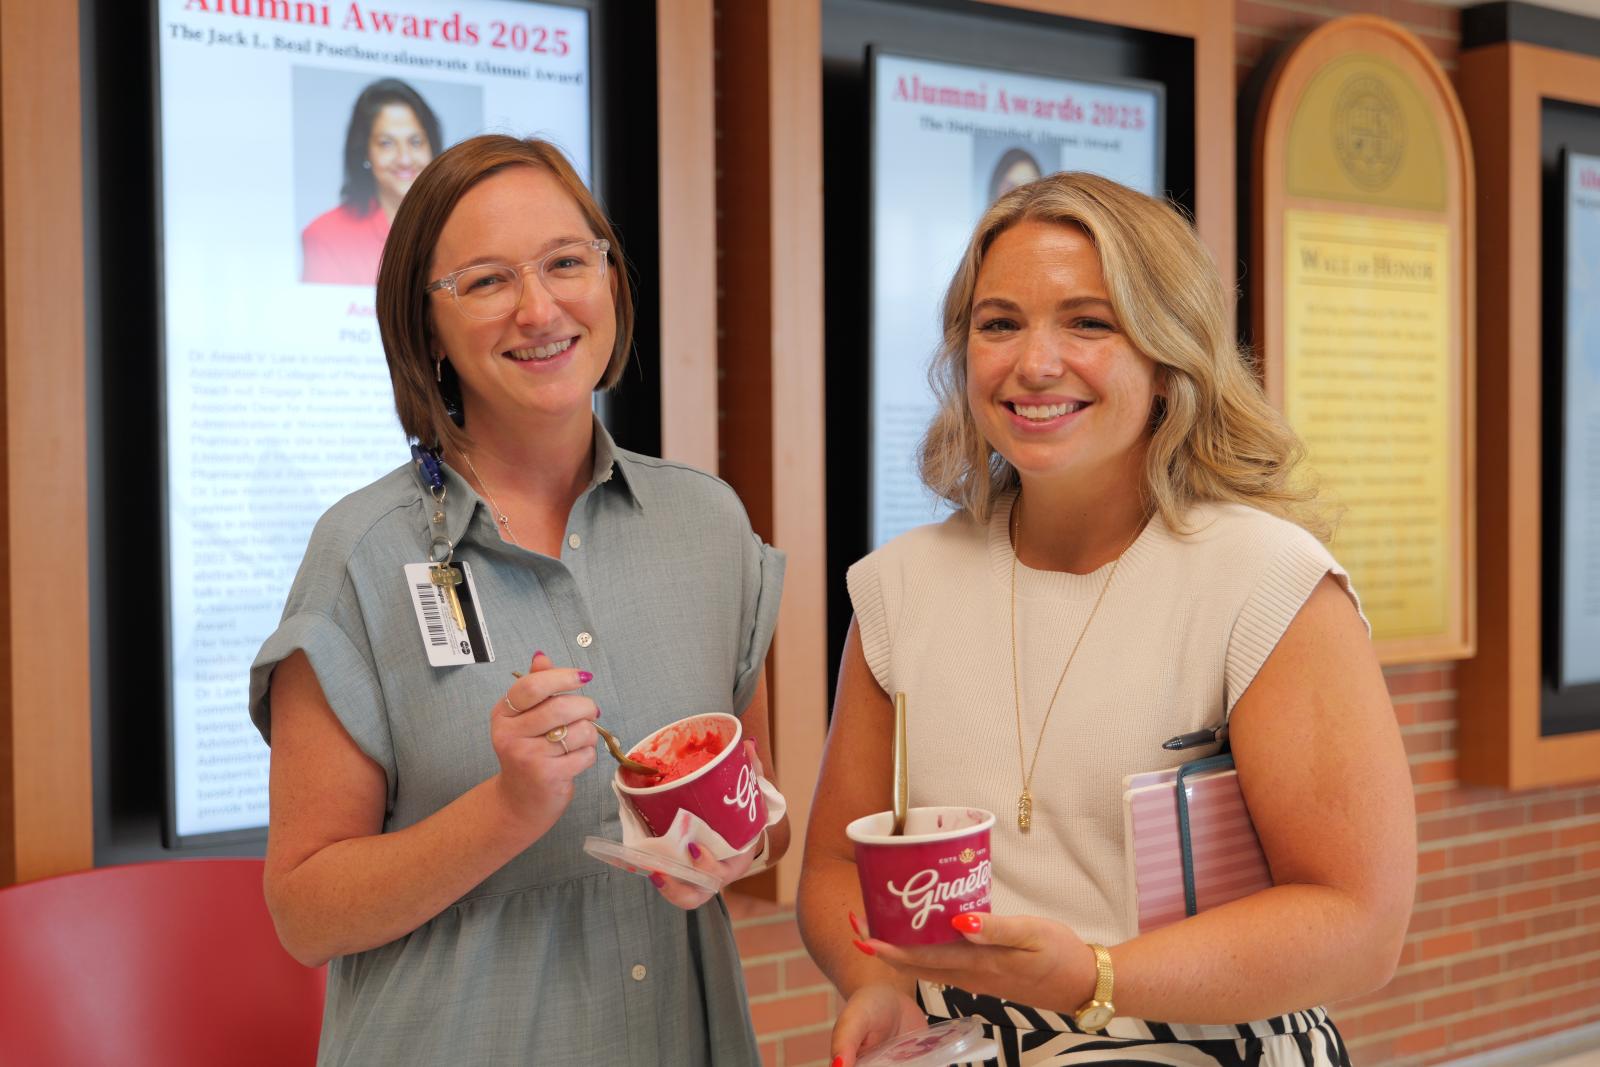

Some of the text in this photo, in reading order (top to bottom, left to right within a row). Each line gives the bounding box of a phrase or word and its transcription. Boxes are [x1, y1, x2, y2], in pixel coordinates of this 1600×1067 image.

[169, 23, 202, 40] The
[207, 28, 248, 46] Jack
[342, 2, 480, 46] Awards
[489, 20, 571, 57] 2025
[892, 74, 987, 111] Alumni
[994, 89, 1084, 124] Awards
[887, 860, 992, 930] Graete
[960, 901, 975, 912] ICE
